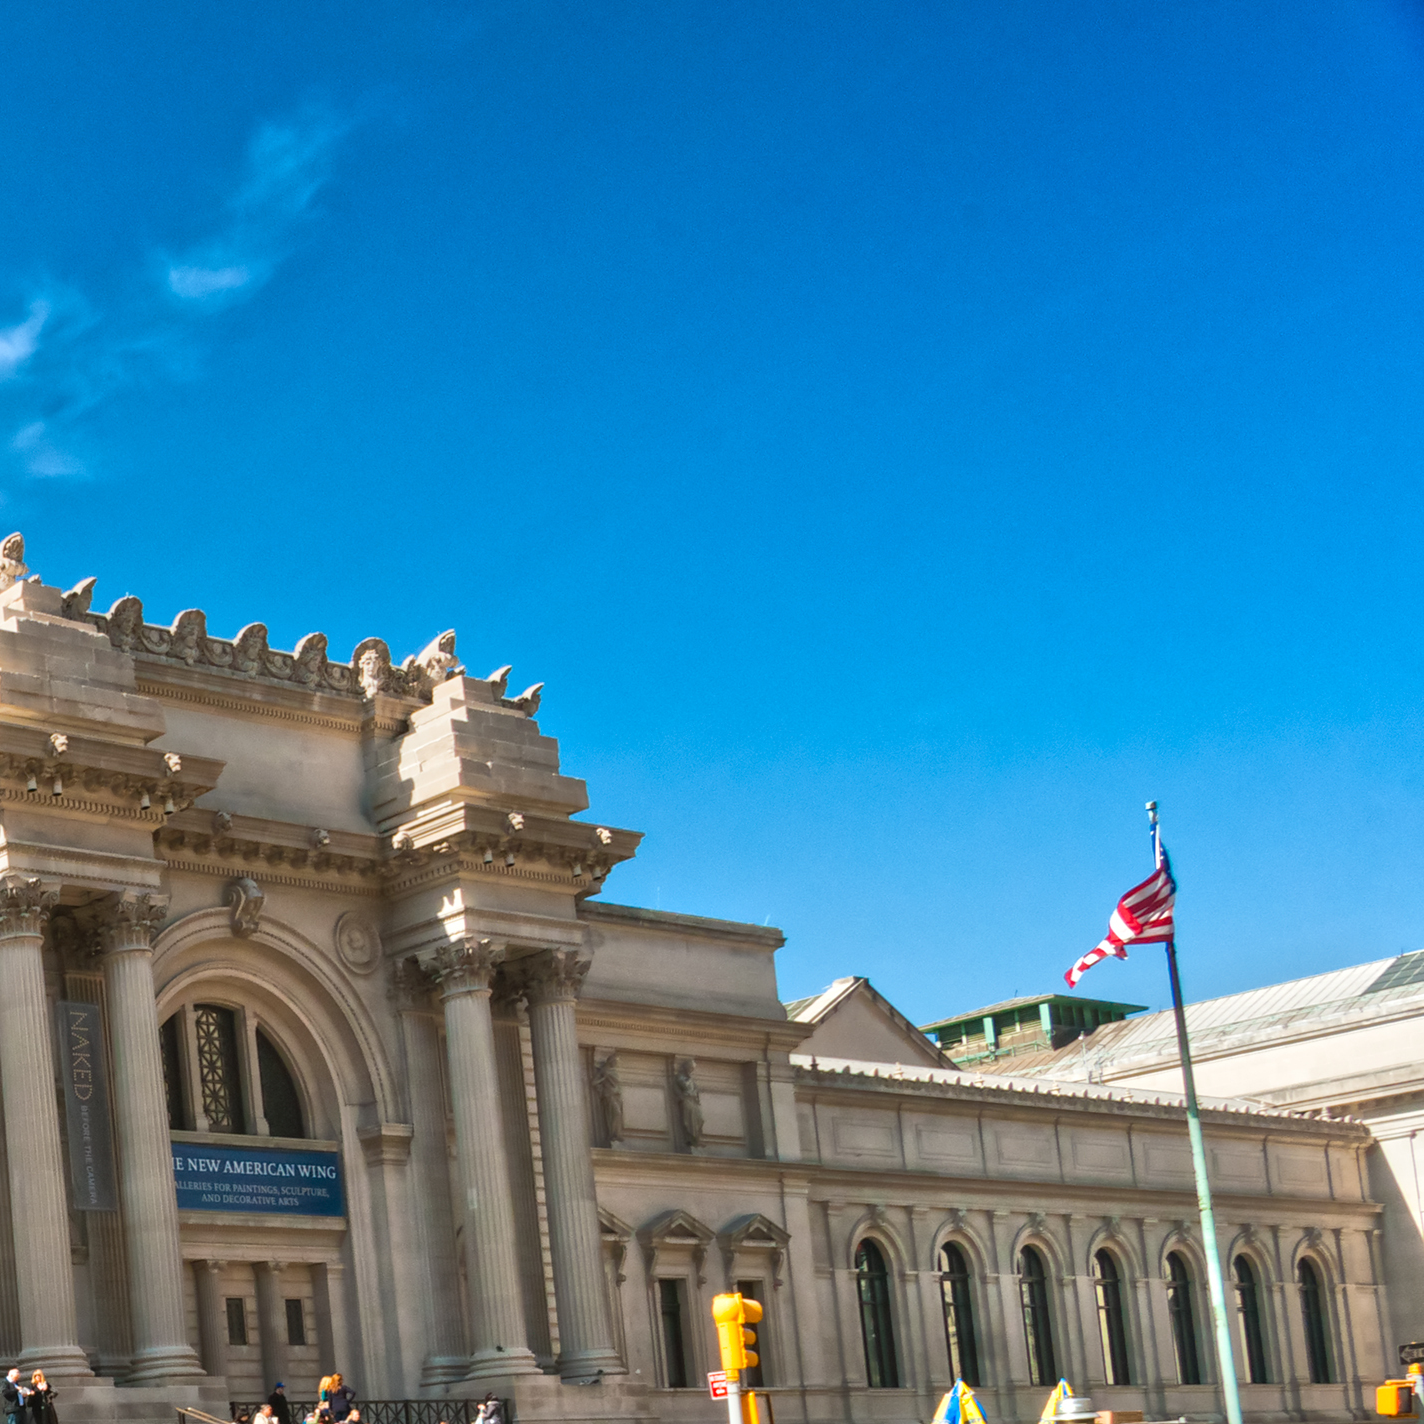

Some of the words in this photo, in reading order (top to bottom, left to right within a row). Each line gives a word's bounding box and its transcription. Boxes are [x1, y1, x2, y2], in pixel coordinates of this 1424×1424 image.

[70, 1011, 93, 1100] NAKED
[80, 1105, 90, 1141] BEFORE
[83, 1145, 93, 1165] THE
[187, 1157, 221, 1173] NEW
[223, 1160, 298, 1177] AMERICAN
[298, 1165, 336, 1179] WING
[86, 1166, 98, 1204] CAMERA
[175, 1180, 213, 1192] ALLERIES
[214, 1182, 232, 1193] FOR
[232, 1183, 280, 1196] PAINTINGS,
[281, 1186, 330, 1198] SCULPTURE,
[202, 1193, 221, 1204] AND
[222, 1194, 277, 1206] DECORATIVE
[278, 1196, 300, 1206] ARTS
